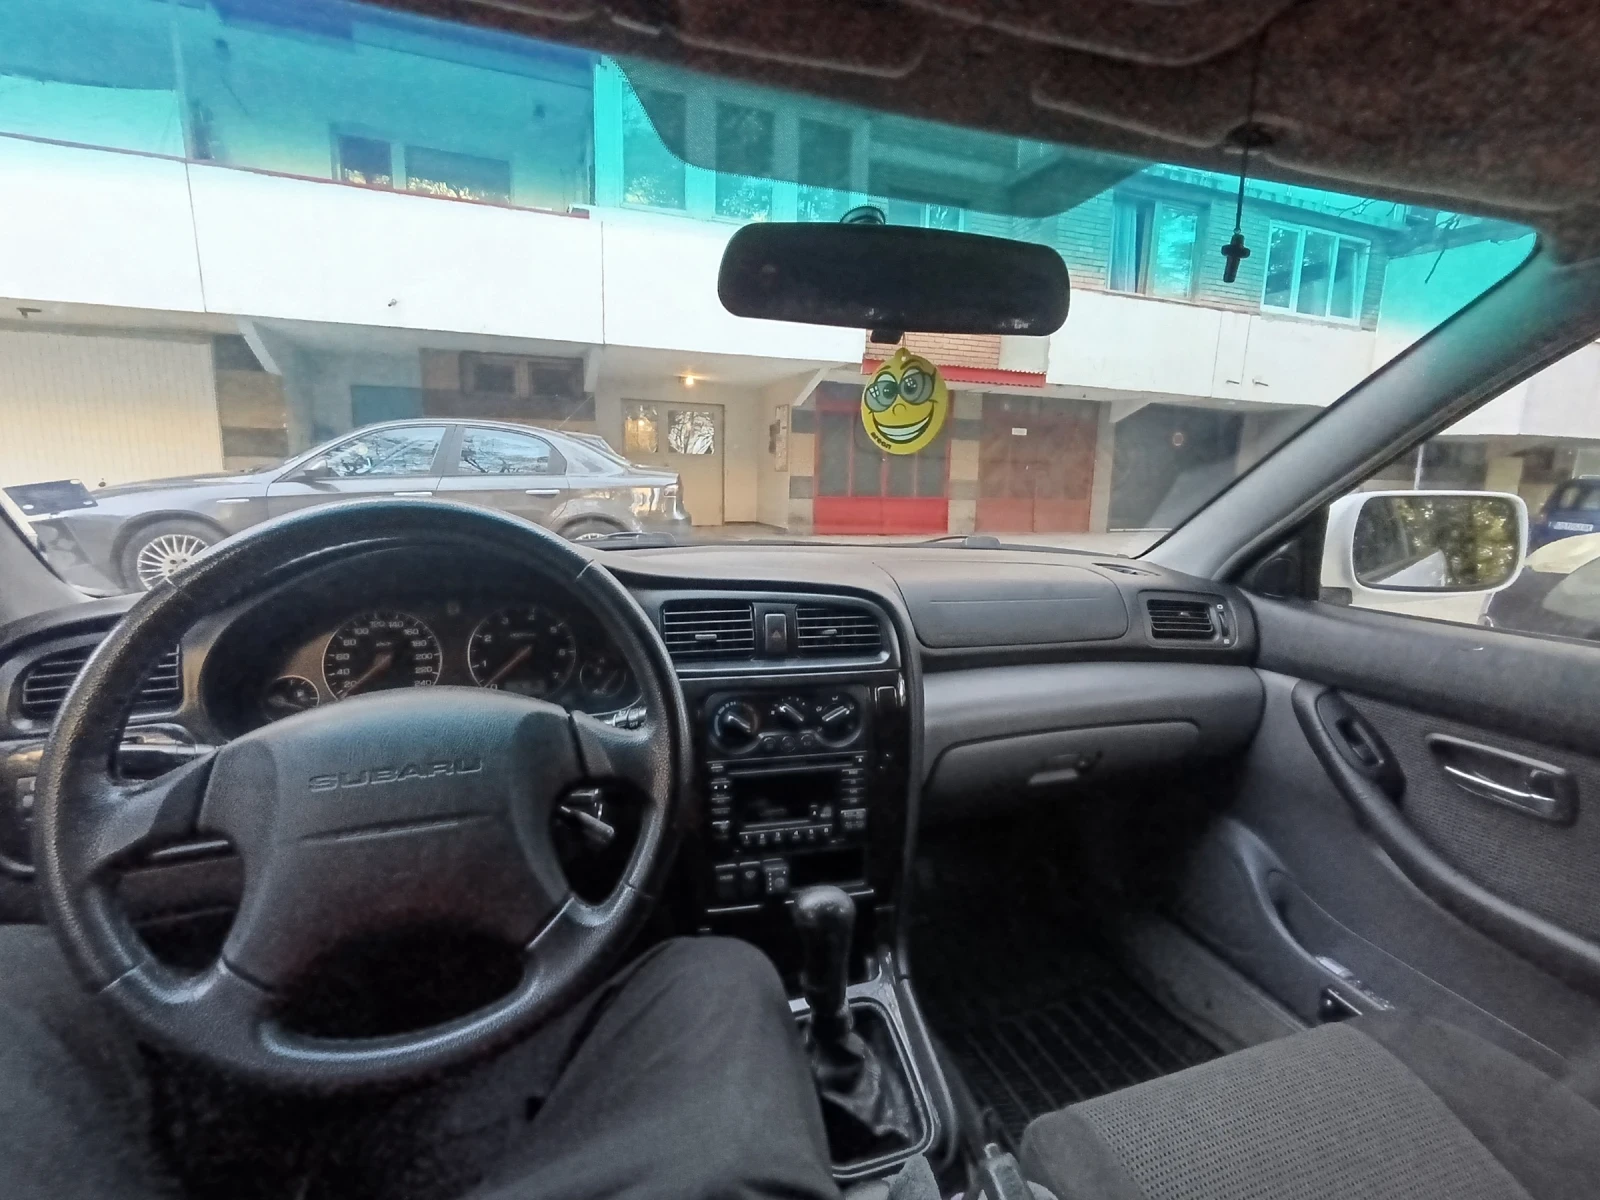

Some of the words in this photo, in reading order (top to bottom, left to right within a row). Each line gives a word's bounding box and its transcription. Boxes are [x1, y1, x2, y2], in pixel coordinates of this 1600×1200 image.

[870, 432, 892, 450] areon
[388, 620, 404, 628] 140
[354, 627, 369, 635] 100
[484, 634, 492, 643] 2
[343, 639, 357, 647] 80
[411, 639, 427, 647] 180
[336, 667, 350, 675] 40
[415, 666, 433, 674] 220
[343, 680, 358, 688] 20
[308, 758, 484, 793] SUBARU
